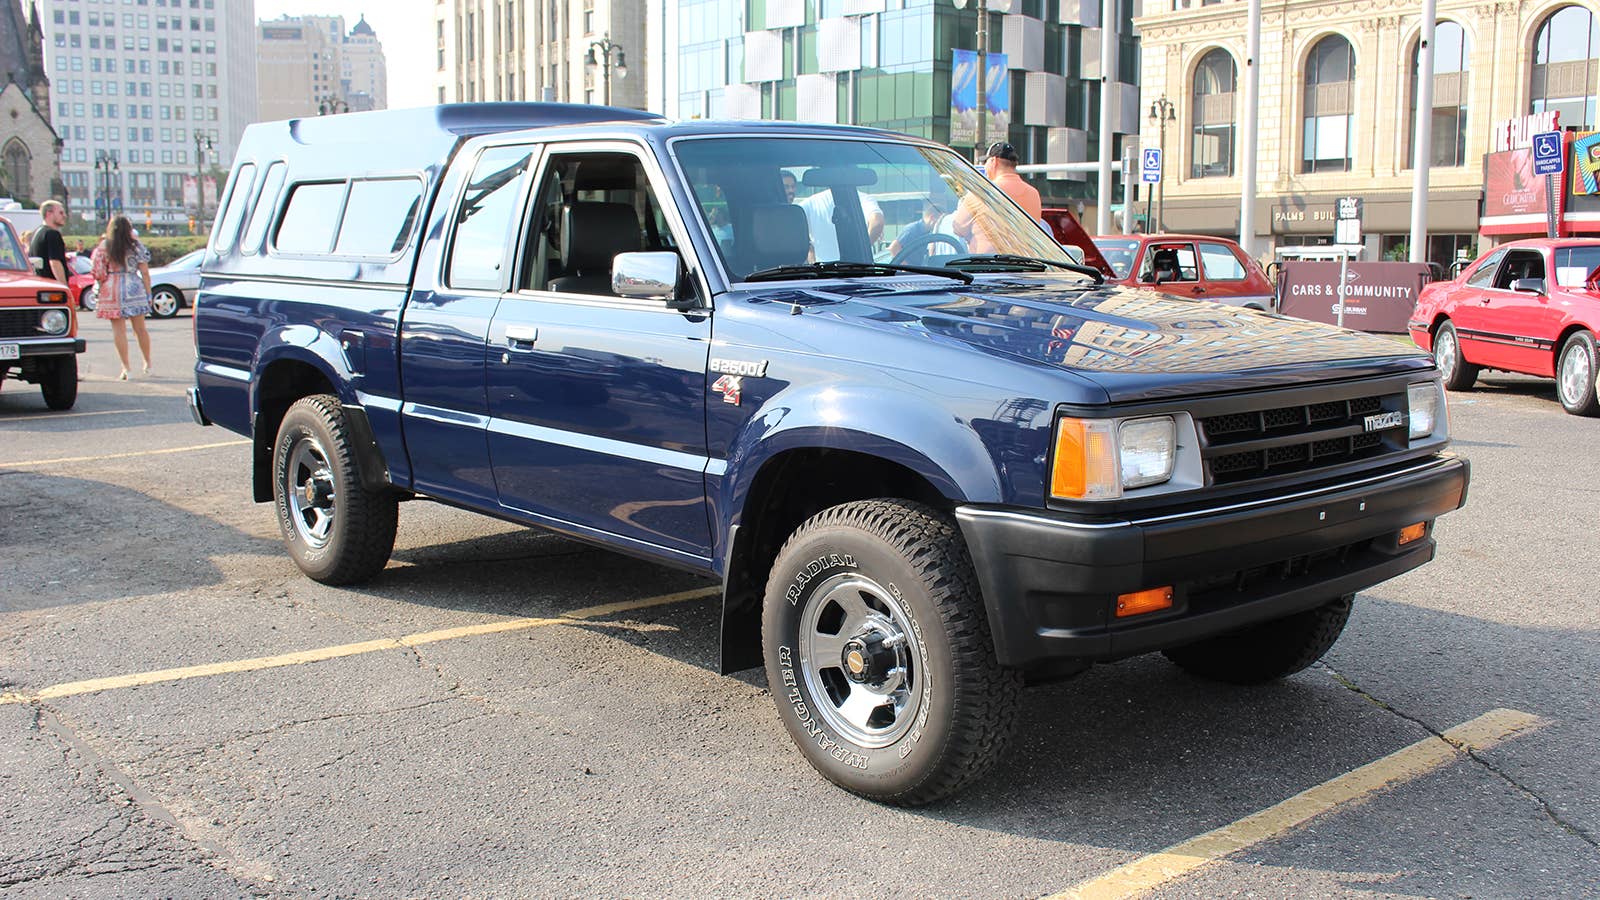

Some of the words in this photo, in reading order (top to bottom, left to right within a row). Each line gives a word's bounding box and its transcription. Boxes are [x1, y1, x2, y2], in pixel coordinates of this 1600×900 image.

[1495, 119, 1510, 153] THE
[1511, 110, 1559, 149] FILLMORE
[1536, 158, 1560, 166] HANDICAPPED
[1275, 212, 1304, 221] PALMS
[1340, 197, 1357, 208] PAY
[1292, 284, 1321, 296] CARS
[1325, 284, 1333, 296] &
[1337, 285, 1411, 298] COMMUNITY
[785, 553, 858, 606] RADIAL
[889, 583, 932, 759] GOODYEAR
[779, 645, 870, 770] WRANGLER
